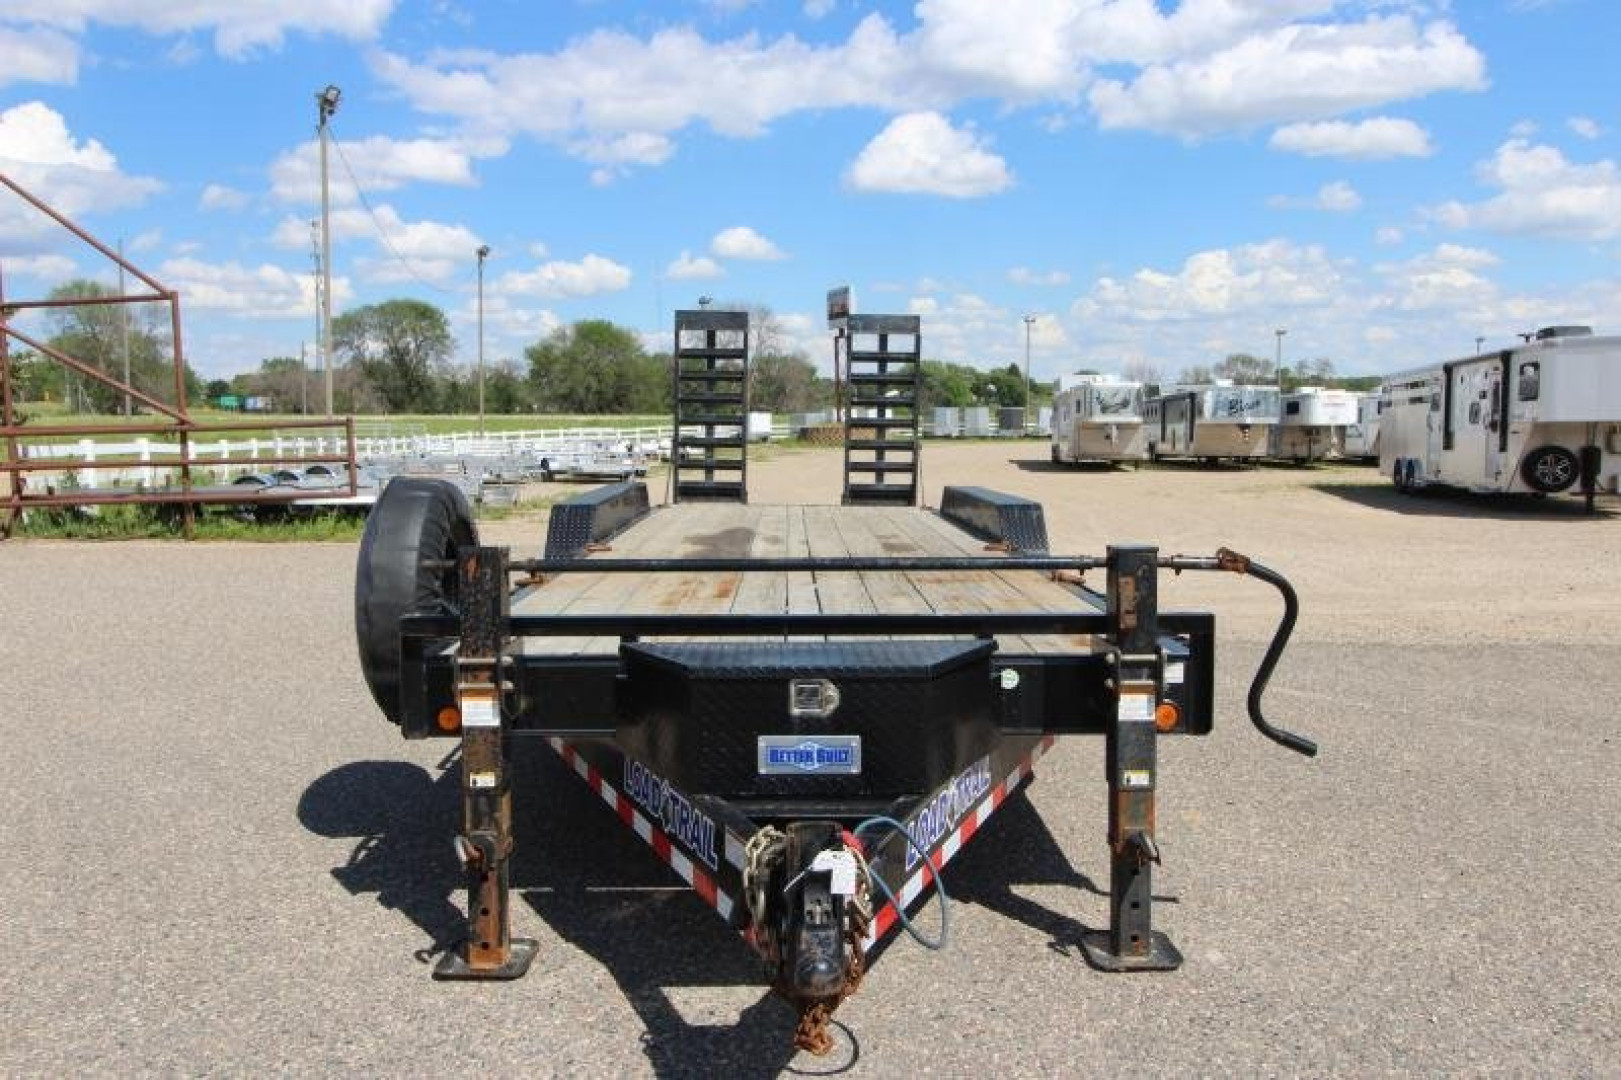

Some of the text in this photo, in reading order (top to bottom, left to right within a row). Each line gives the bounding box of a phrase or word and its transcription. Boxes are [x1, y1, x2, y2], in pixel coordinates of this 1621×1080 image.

[623, 757, 718, 872] LOAD TRAIL
[953, 756, 991, 820] TRAIL
